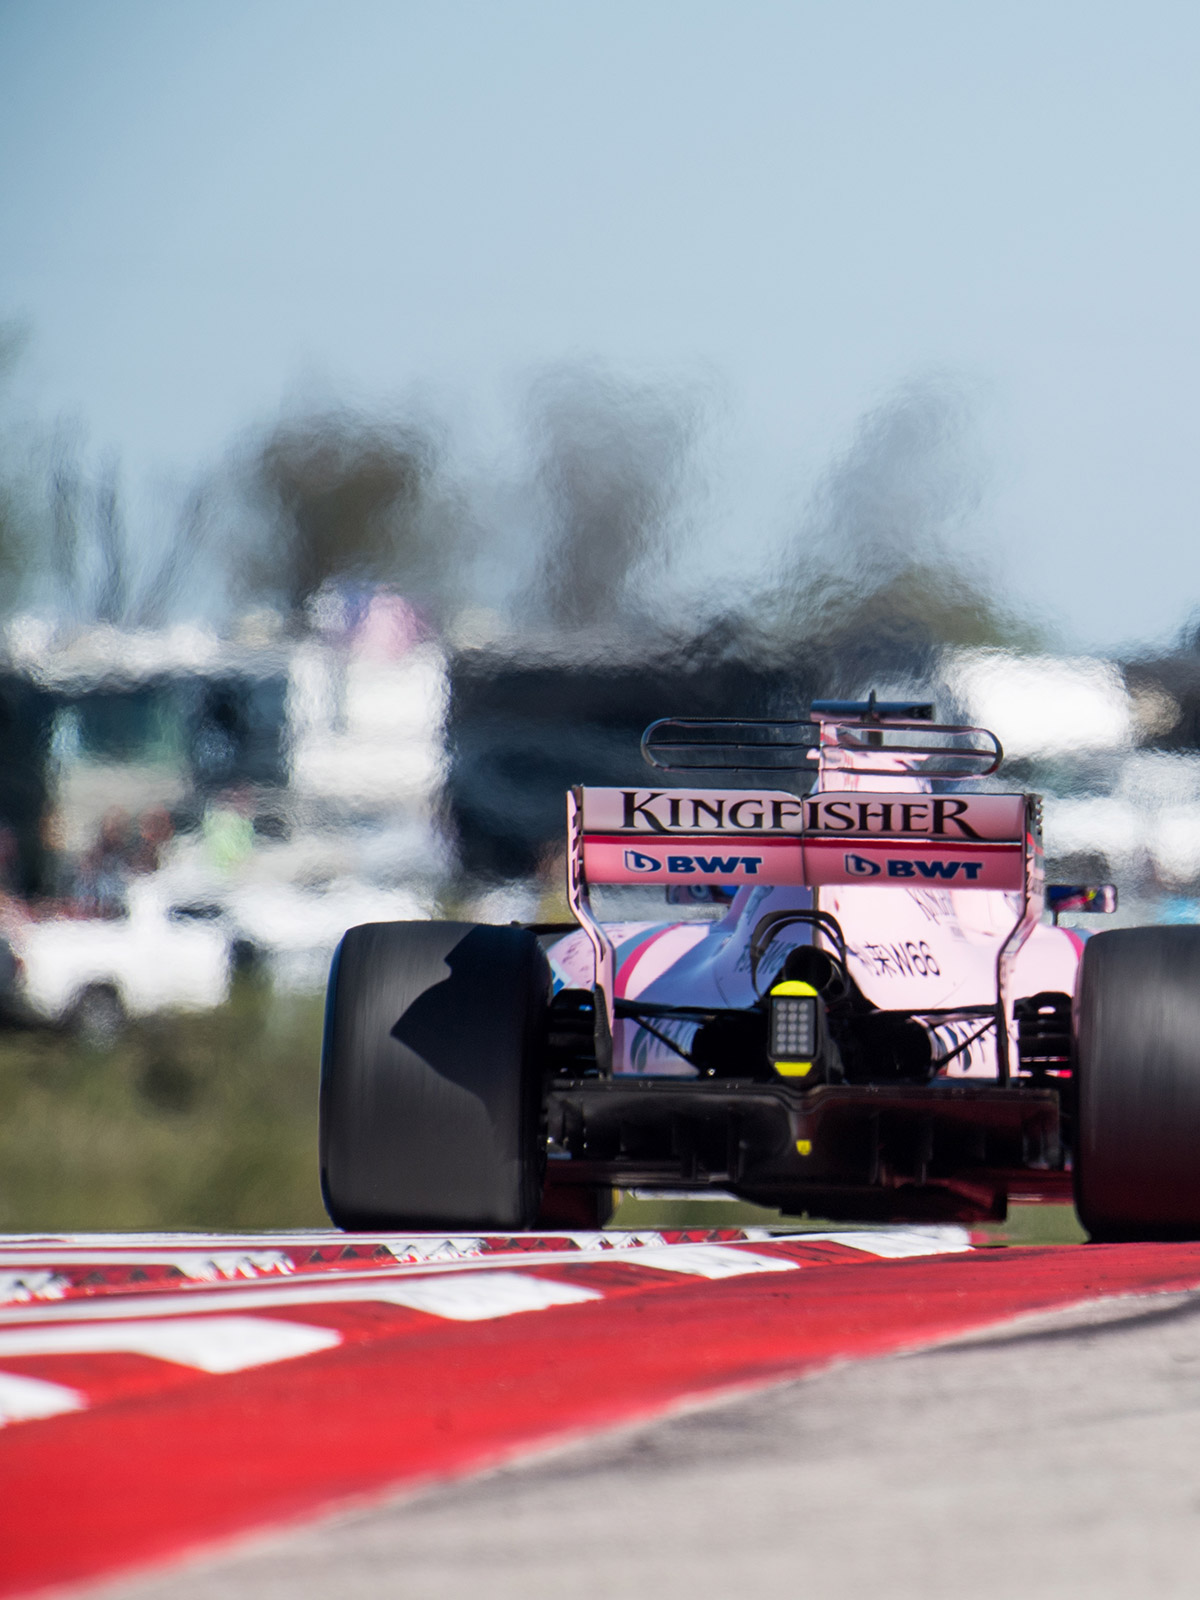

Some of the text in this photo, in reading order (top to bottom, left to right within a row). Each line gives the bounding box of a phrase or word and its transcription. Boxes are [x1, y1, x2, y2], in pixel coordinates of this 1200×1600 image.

[620, 790, 984, 840] KINGFISHER
[667, 855, 763, 875] BWT
[887, 859, 983, 880] BWT
